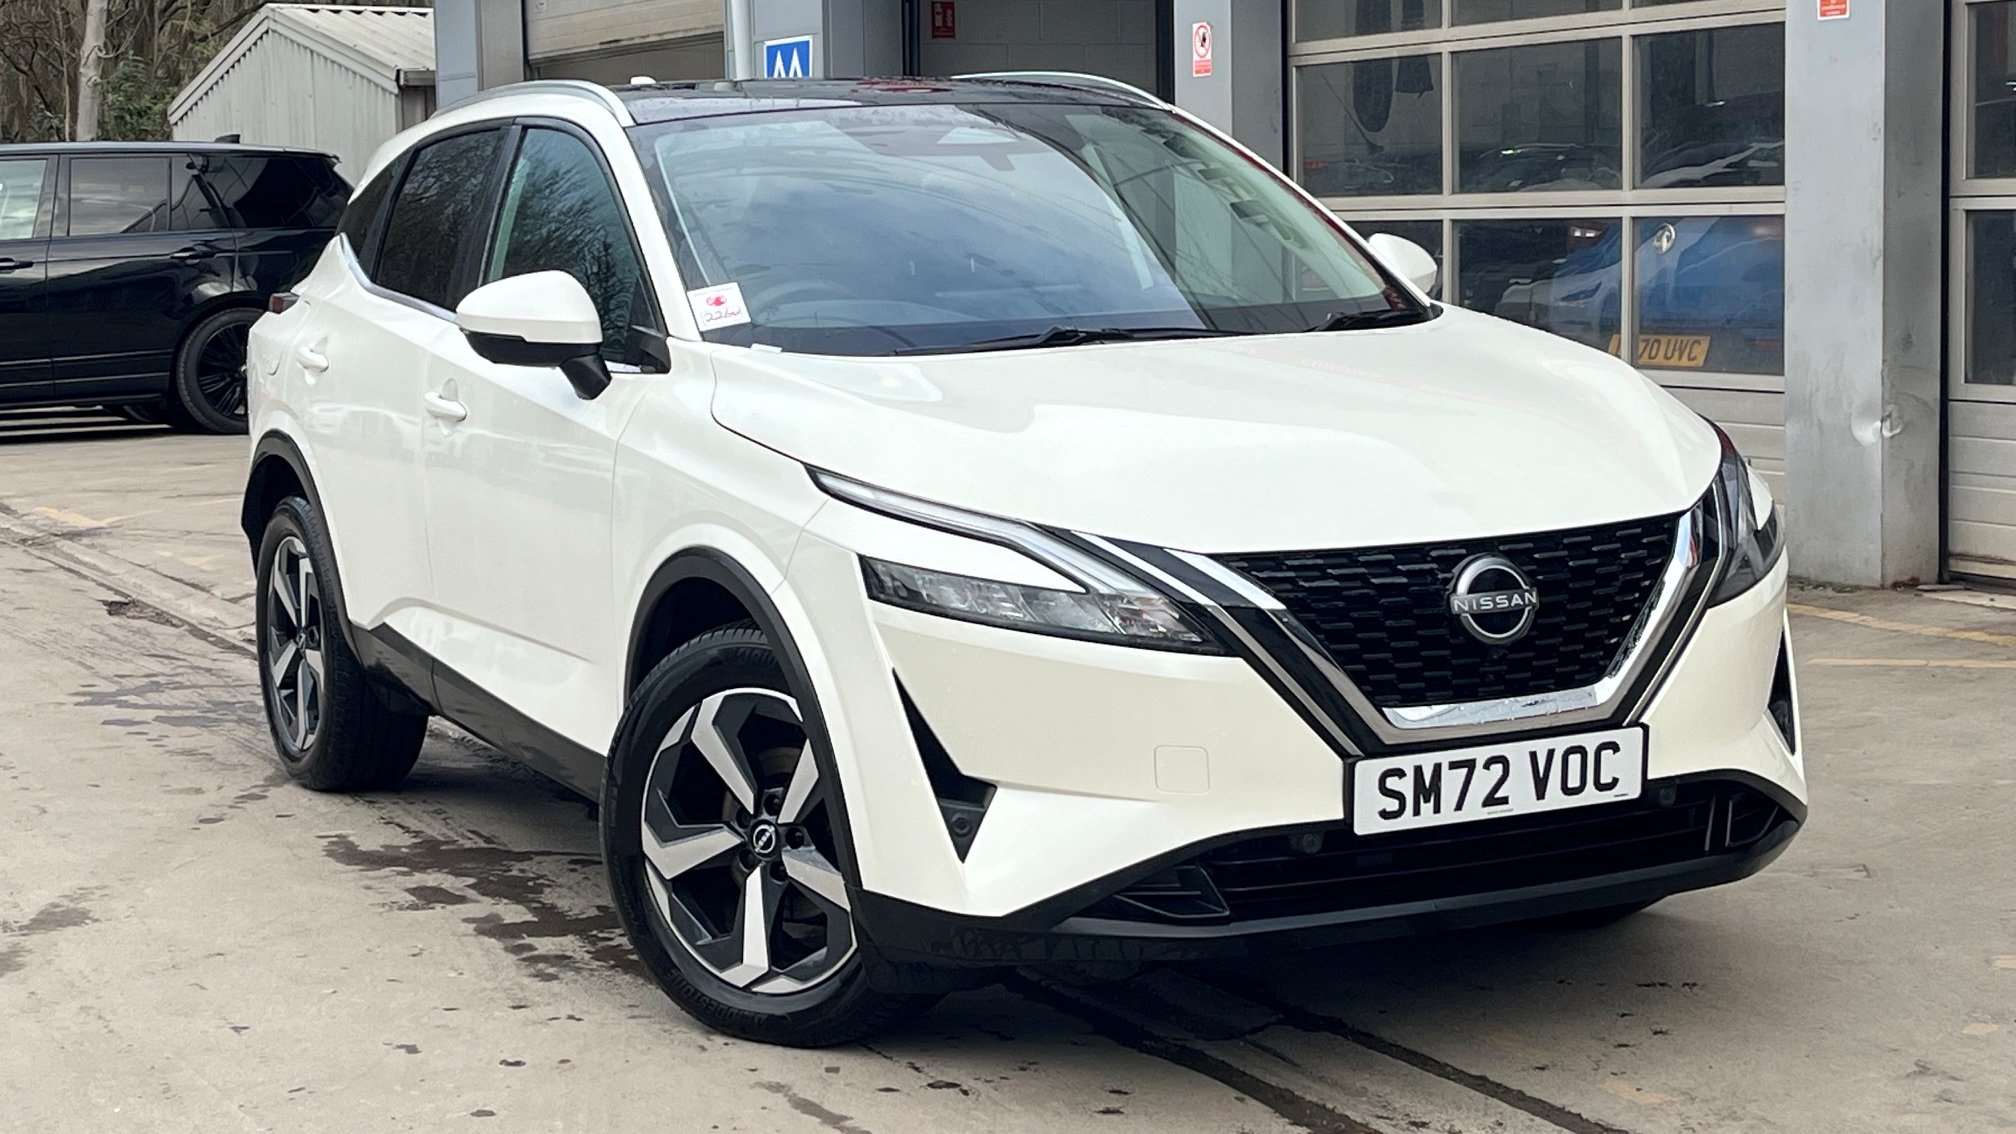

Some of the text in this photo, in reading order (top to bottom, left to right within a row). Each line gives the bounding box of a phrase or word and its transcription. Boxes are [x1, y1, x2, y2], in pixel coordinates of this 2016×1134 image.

[1663, 338, 1702, 362] UVC
[1453, 591, 1537, 612] NISSAN
[1377, 740, 1621, 821] SM72 VOC
